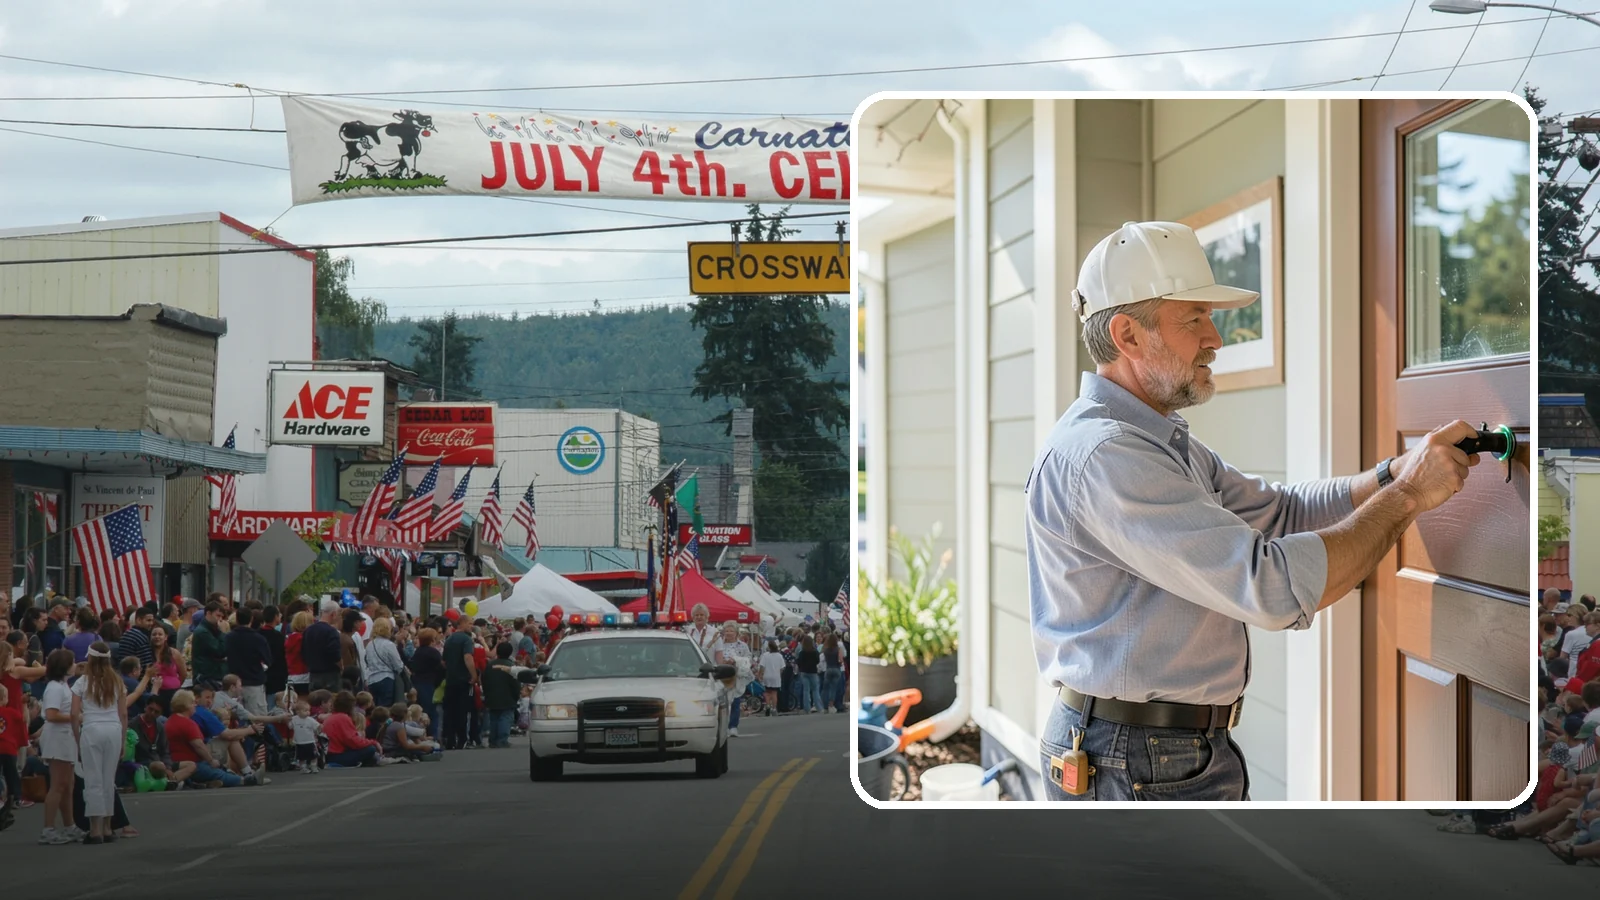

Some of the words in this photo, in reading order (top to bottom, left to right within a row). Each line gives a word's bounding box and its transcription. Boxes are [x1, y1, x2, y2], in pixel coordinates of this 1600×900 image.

[481, 140, 605, 192] JULY
[632, 150, 746, 198] 4th.
[697, 254, 850, 280] CROSSWA
[282, 379, 374, 420] ACE
[405, 408, 453, 422] CEDAR
[461, 409, 485, 422] LOG
[283, 421, 371, 436] Hardware
[416, 428, 477, 447] Coca-Cola
[82, 486, 93, 495] St.
[95, 485, 124, 495] Vincent
[126, 485, 136, 495] de
[137, 485, 155, 495] Paul
[688, 526, 741, 535] CRNATION
[699, 535, 730, 543] GLASS
